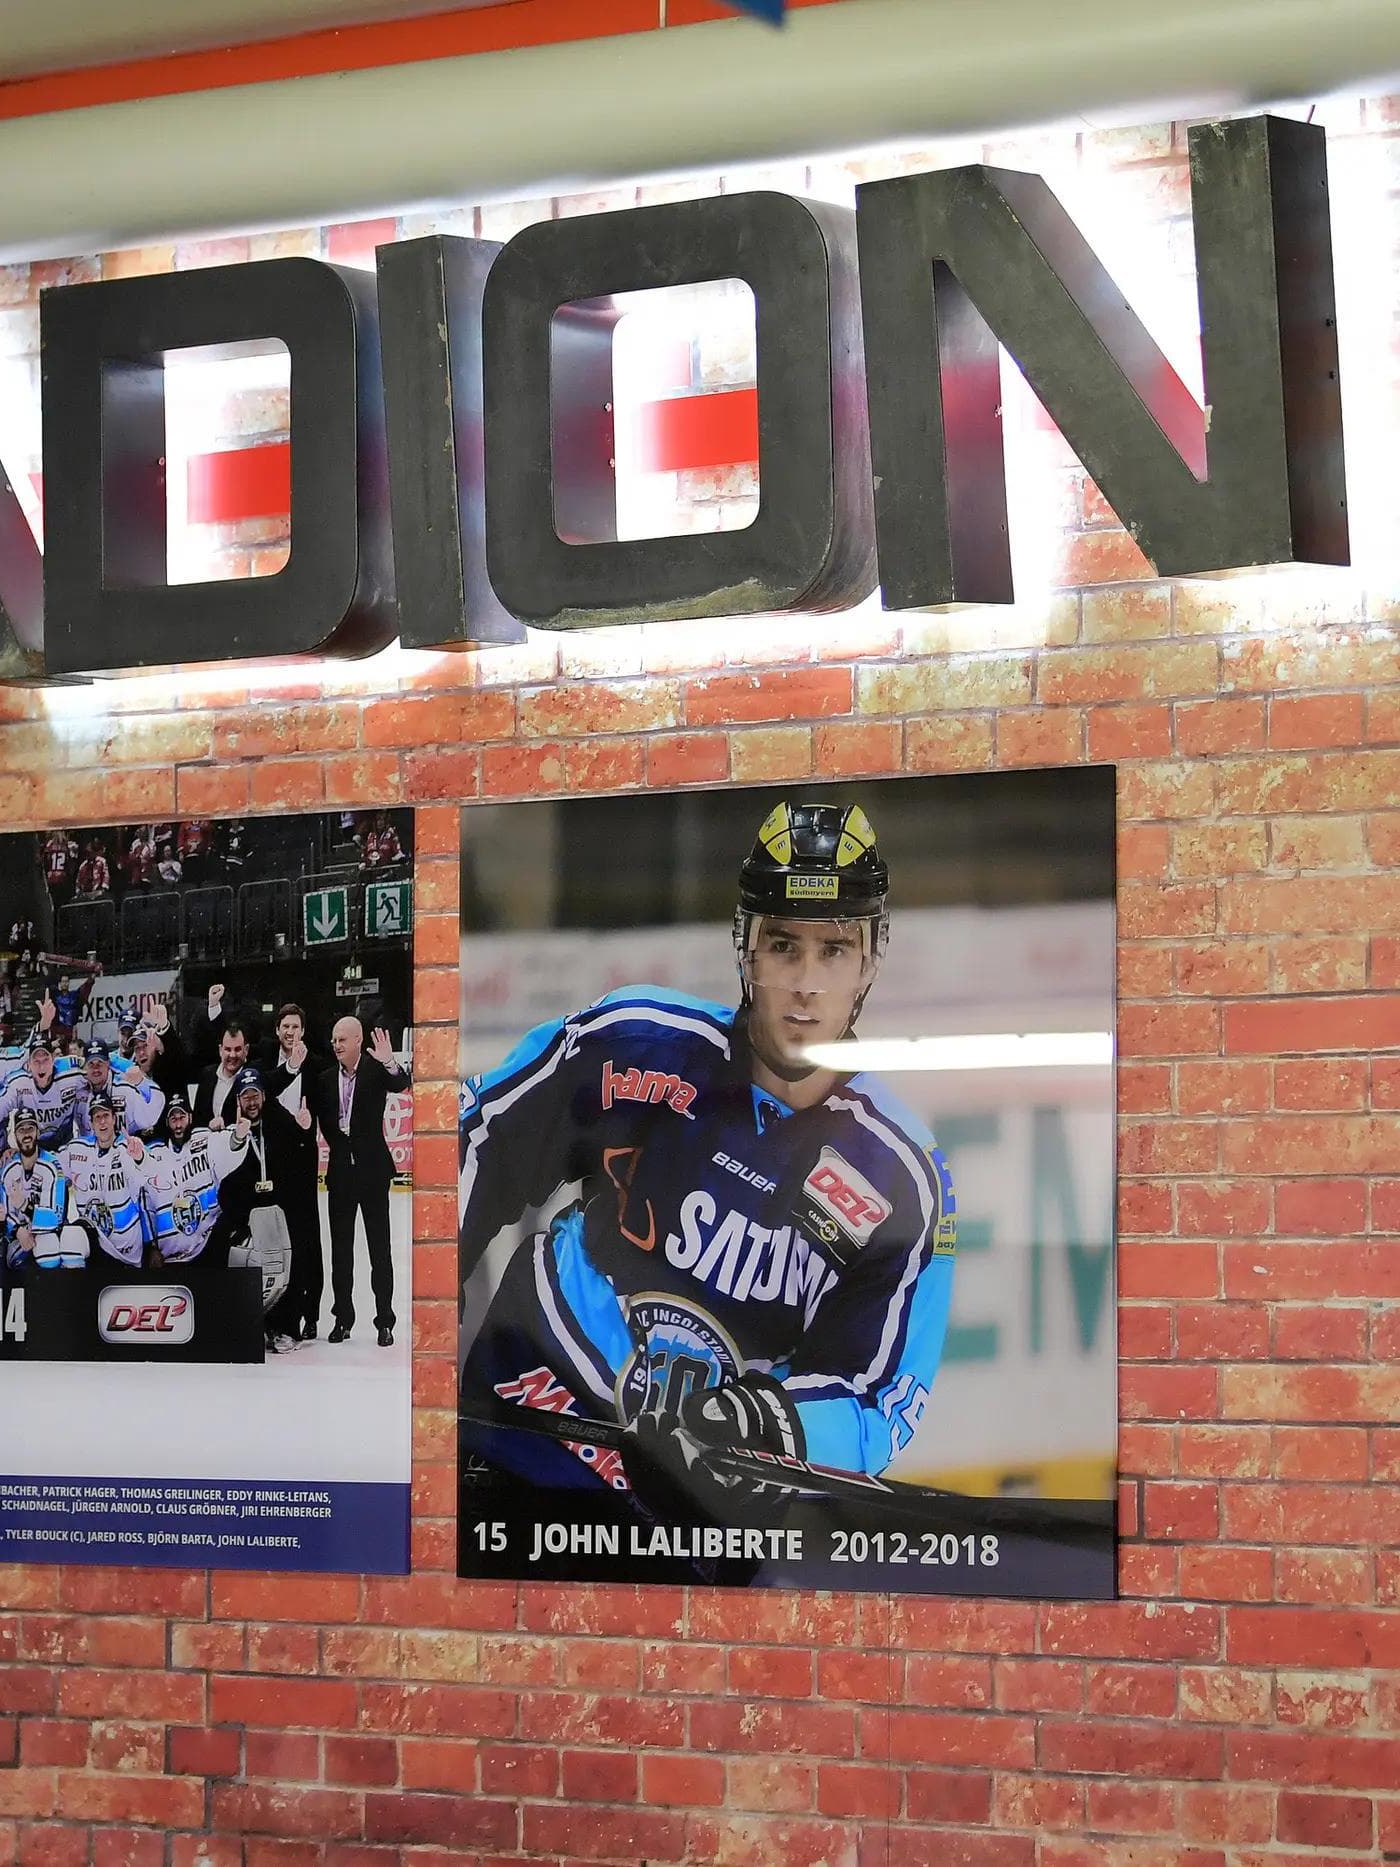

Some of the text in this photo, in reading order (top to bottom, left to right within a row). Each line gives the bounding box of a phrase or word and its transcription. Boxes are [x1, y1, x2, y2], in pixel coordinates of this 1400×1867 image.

[790, 877, 835, 889] EDEKA
[601, 1060, 697, 1121] hama
[711, 1151, 777, 1195] BAUER
[808, 1166, 886, 1228] DEL
[106, 1294, 186, 1332] DEL
[2, 1500, 70, 1514] SCHAIDNAGEL,
[71, 1499, 108, 1515] JÜRGEN
[110, 1502, 154, 1516] ARNOLD,
[155, 1503, 187, 1515] CLAUS
[188, 1502, 239, 1518] GRÖBNER,
[240, 1505, 258, 1518] JIRI
[260, 1506, 332, 1519] EHRENBERGER
[42, 1486, 82, 1498] PATRICK
[84, 1487, 118, 1501] HAGER,
[120, 1487, 162, 1500] THOMAS
[164, 1488, 224, 1503] GREILINGER,
[226, 1490, 252, 1502] EDDY
[255, 1490, 332, 1505] RINKE-LEITANS,
[5, 1529, 33, 1541] TYLER
[35, 1529, 69, 1542] BOUCK
[86, 1531, 116, 1544] JARED
[118, 1532, 146, 1546] ROSS,
[147, 1530, 180, 1545] BJÖRN
[181, 1533, 216, 1547] BARTA,
[218, 1534, 245, 1548] JOHN
[247, 1535, 301, 1550] LALIBERTE,
[472, 1521, 1000, 1567] 15 JOHN LALIBERTE 2012-2018
